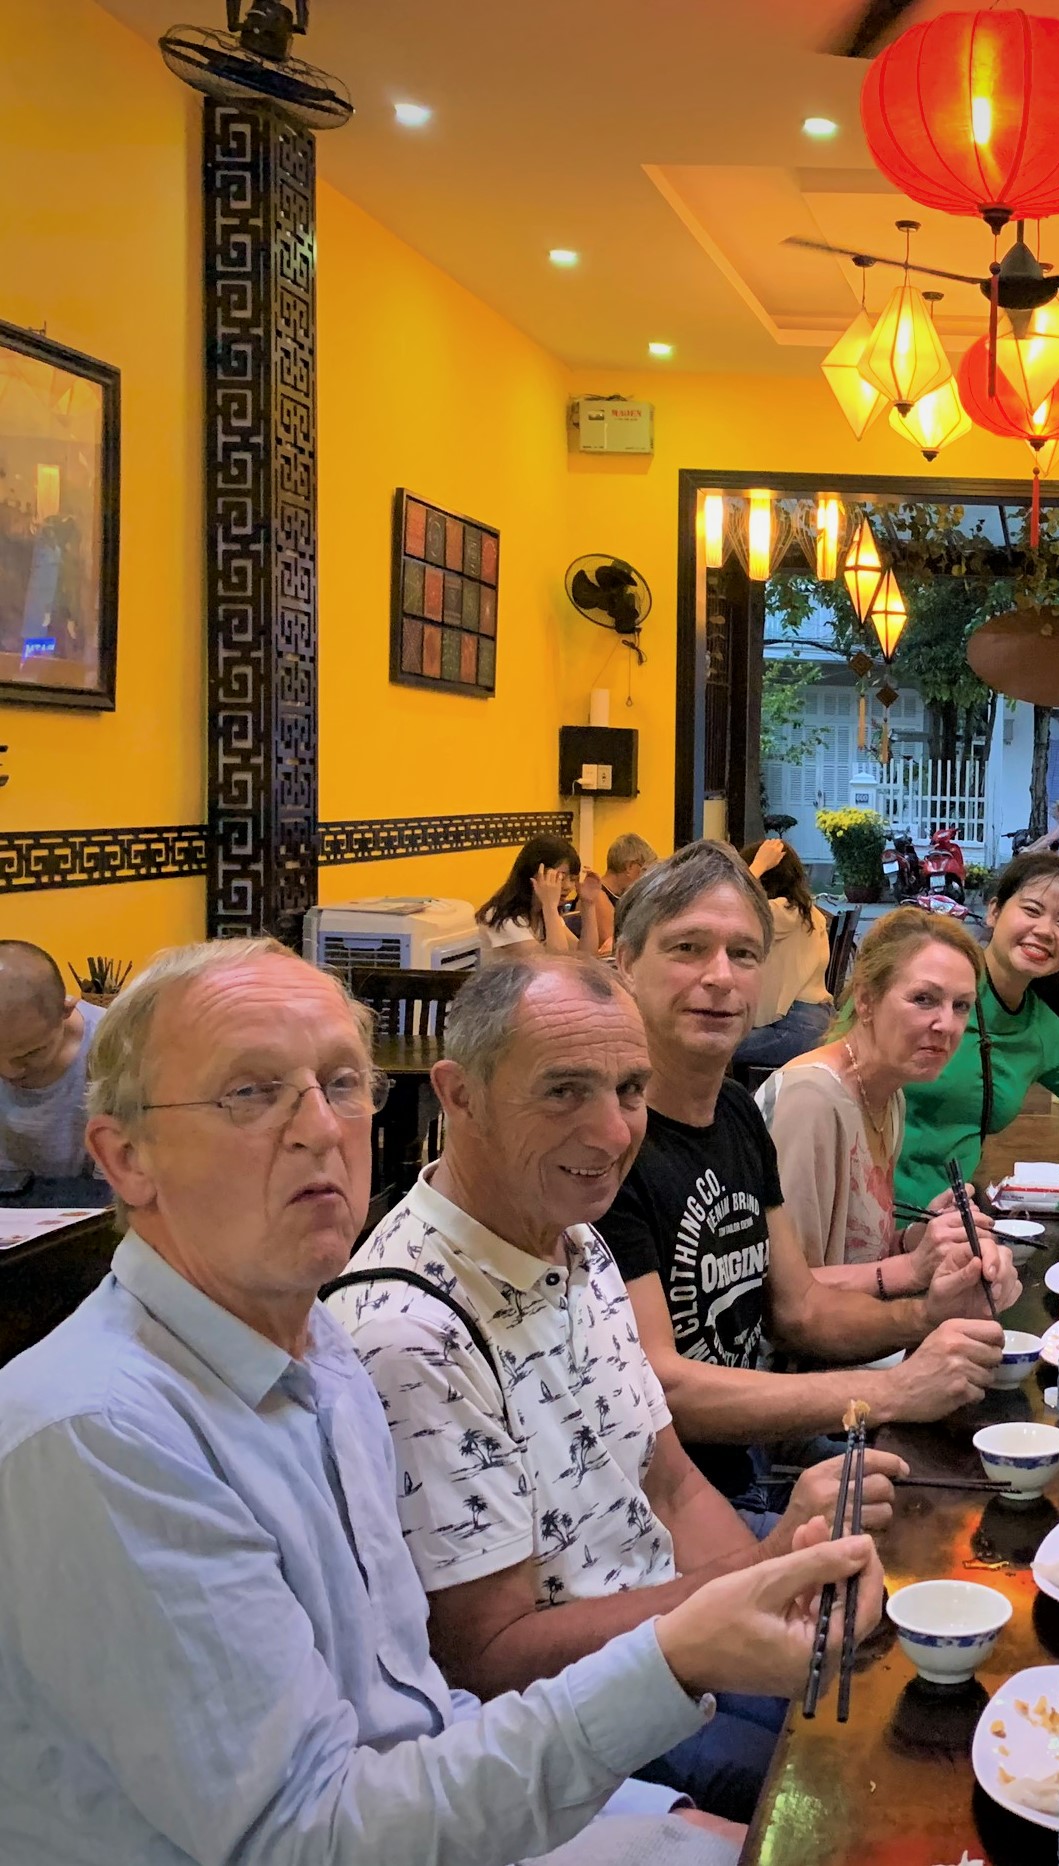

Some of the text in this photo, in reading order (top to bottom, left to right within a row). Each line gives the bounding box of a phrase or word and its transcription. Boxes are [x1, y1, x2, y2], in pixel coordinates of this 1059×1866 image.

[732, 1191, 760, 1216] BRAND
[670, 1195, 706, 1339] CLOTHING
[695, 1168, 726, 1206] CO.
